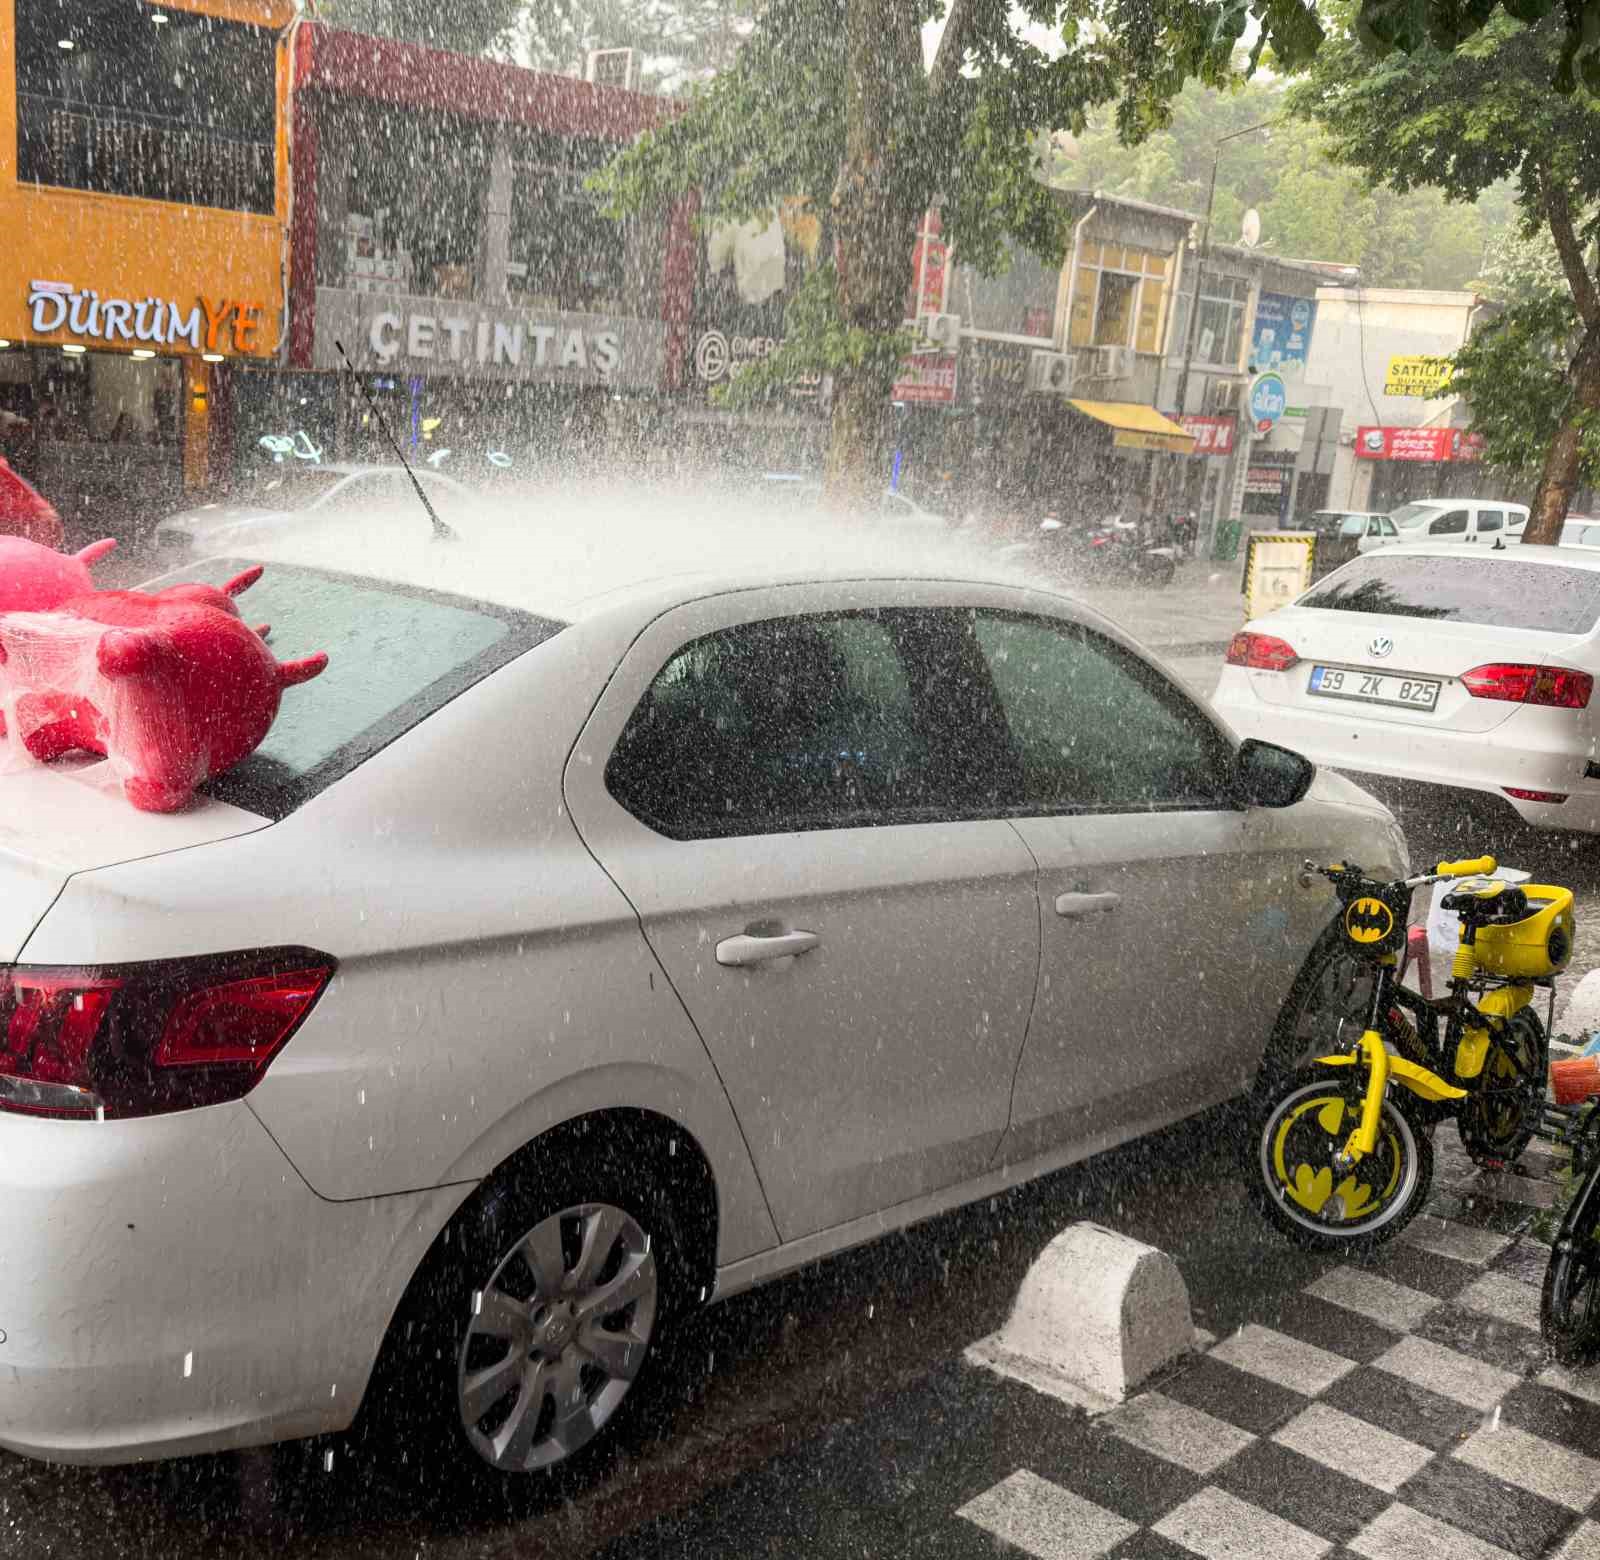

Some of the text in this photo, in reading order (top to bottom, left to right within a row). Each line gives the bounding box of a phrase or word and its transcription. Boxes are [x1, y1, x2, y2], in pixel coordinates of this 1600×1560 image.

[1322, 671, 1345, 690] 59
[1359, 676, 1384, 695] ZK
[1400, 681, 1436, 703] 825
